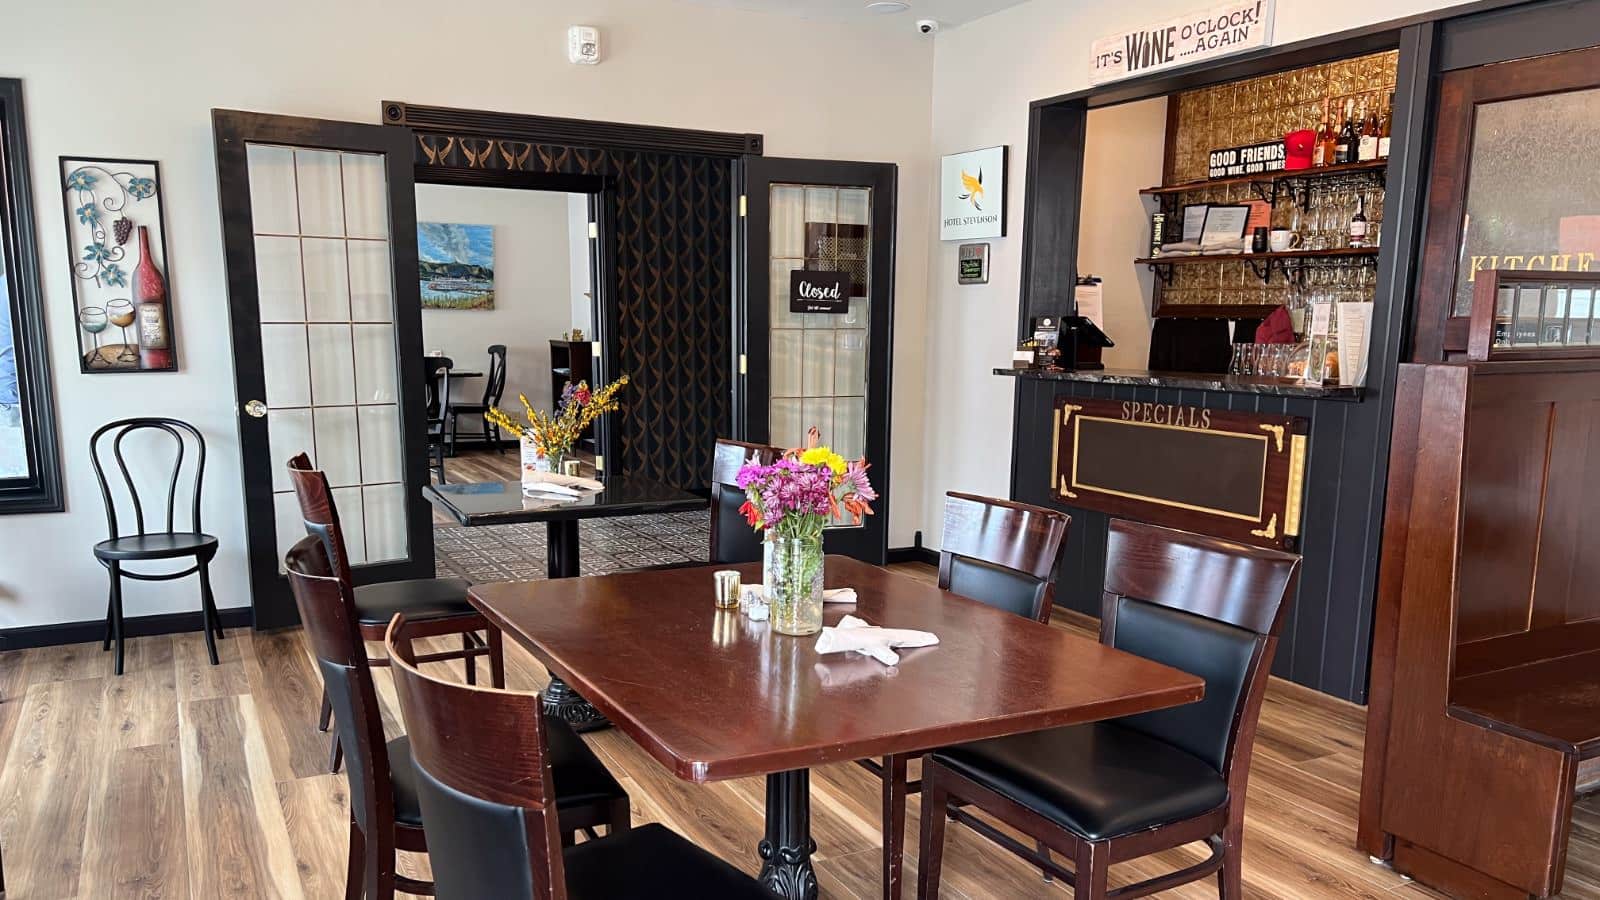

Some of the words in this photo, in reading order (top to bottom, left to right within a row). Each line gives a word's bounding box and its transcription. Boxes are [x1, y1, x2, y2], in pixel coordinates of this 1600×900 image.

[1096, 50, 1122, 69] IT'S
[1125, 26, 1177, 71] WINE
[1181, 0, 1261, 40] O'CLOCK!
[1210, 151, 1236, 167] GOOD
[1209, 168, 1226, 177] GOOD
[1246, 163, 1263, 173] GOOD
[944, 217, 961, 227] HOTEL
[963, 215, 998, 225] STEVENSON
[799, 280, 841, 300] Closed
[1496, 330, 1536, 339] Empyees
[1121, 401, 1211, 429] SPECIALS
